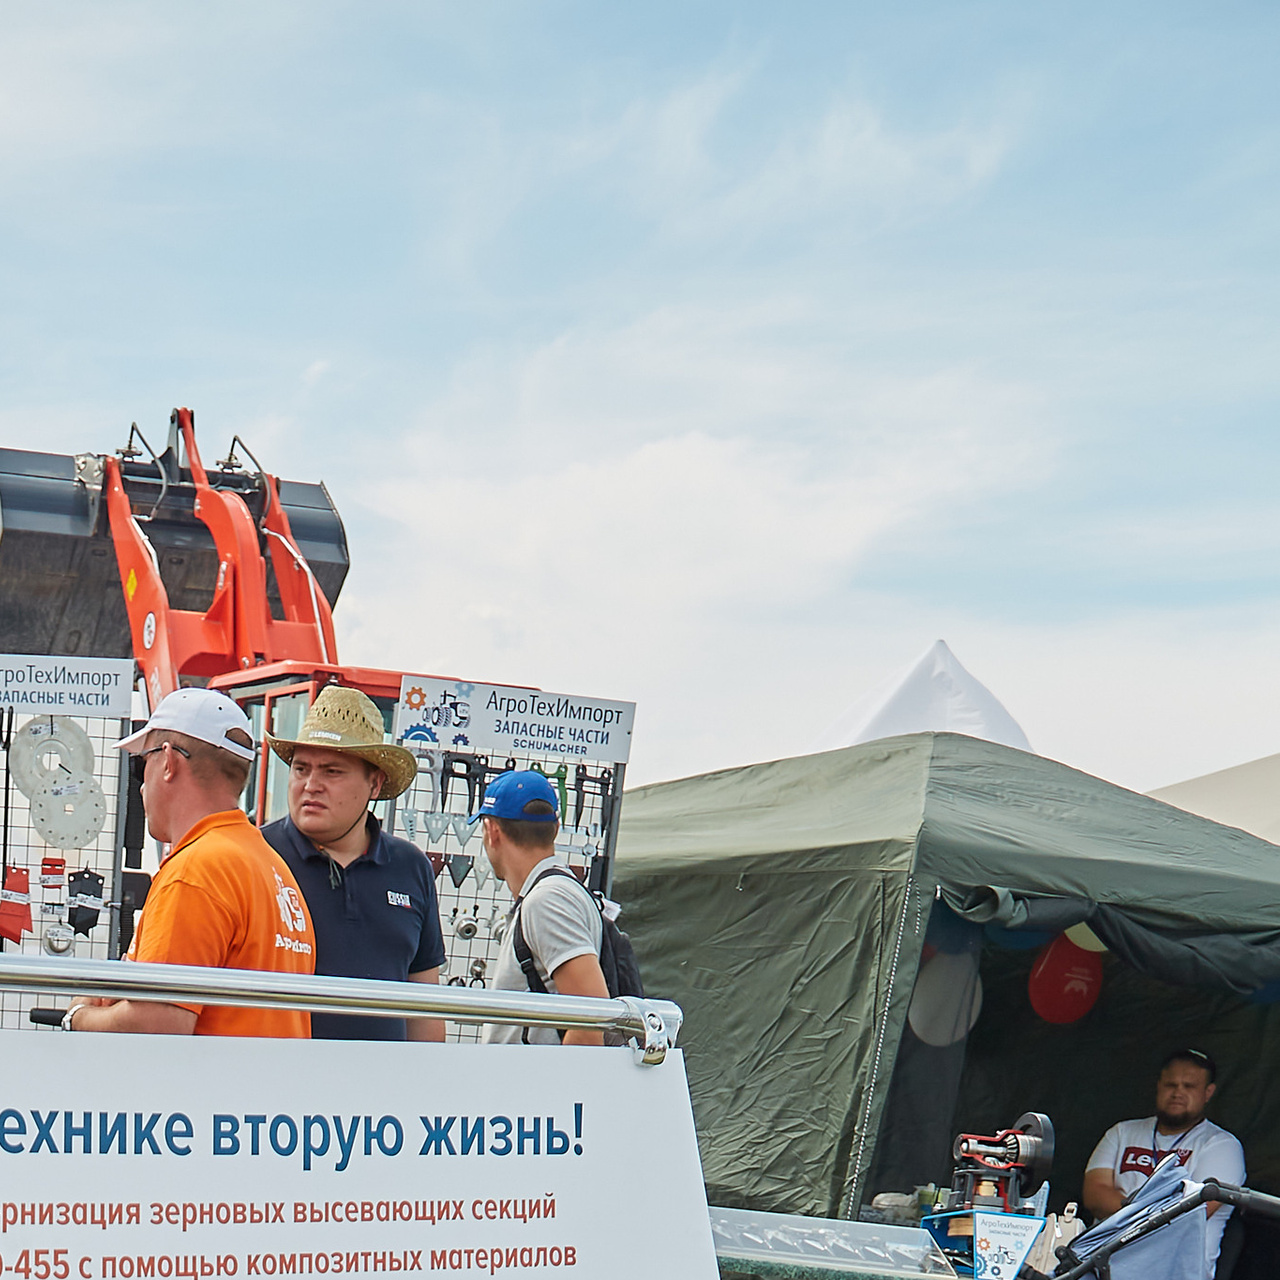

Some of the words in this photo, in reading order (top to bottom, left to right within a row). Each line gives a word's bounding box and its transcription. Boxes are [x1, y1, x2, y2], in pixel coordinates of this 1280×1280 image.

[69, 691, 110, 706] ЧАСТИ
[485, 690, 623, 728] АгроТехИмпорт
[493, 719, 565, 740] ЗАПАСНЫЕ
[568, 727, 610, 745] ЧАСТИ
[513, 738, 588, 755] SCHUMACHER
[212, 1113, 404, 1172] вторую
[418, 1102, 584, 1157] жизнь!
[149, 1202, 286, 1233] зерновых
[293, 1199, 465, 1226] высевающих
[471, 1190, 557, 1225] секций
[78, 1256, 93, 1280] с
[247, 1249, 423, 1276] композитных
[430, 1244, 577, 1276] материалов
